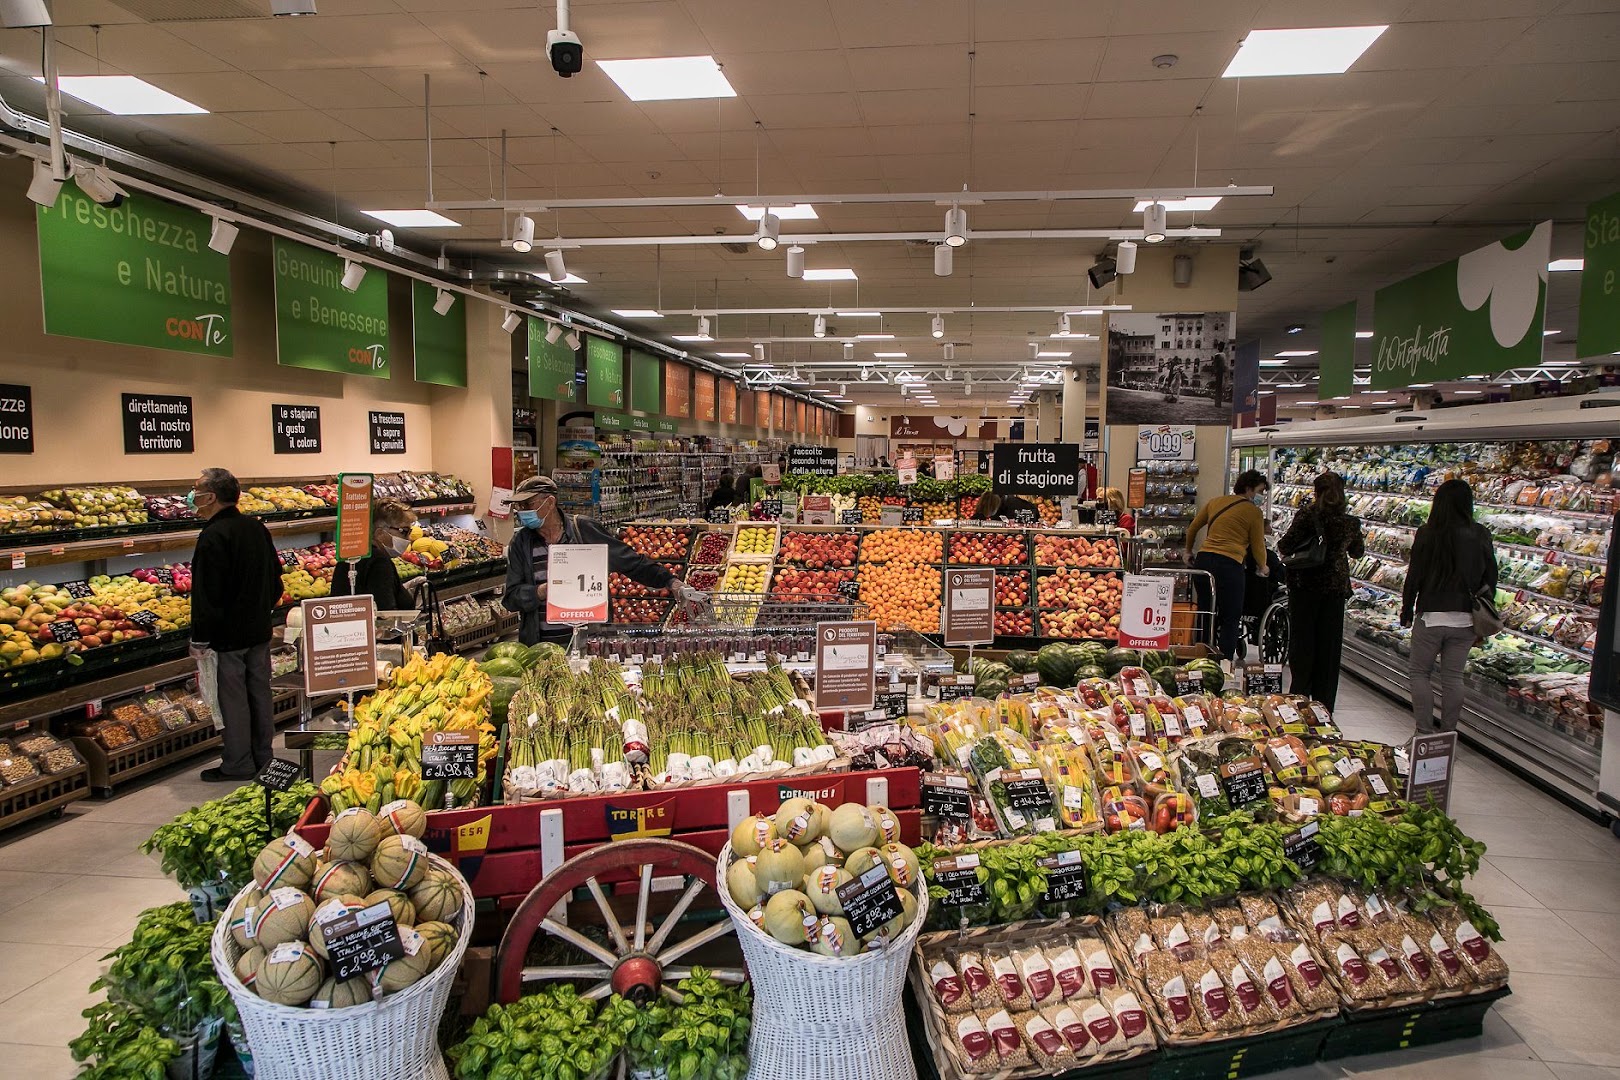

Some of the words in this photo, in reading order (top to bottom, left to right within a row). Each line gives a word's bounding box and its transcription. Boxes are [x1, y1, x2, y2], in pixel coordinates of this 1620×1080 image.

[42, 193, 198, 252] reschezza
[117, 260, 131, 285] e
[146, 257, 226, 304] Natura
[1604, 269, 1614, 295] e
[292, 299, 300, 319] e
[310, 296, 386, 336] Benessere
[128, 398, 188, 414] direttamente
[280, 406, 288, 419] le
[290, 408, 317, 421] stagioni
[372, 414, 378, 424] la
[378, 414, 404, 425] freschezza
[140, 418, 156, 432] dal
[160, 419, 190, 432] nostro
[278, 422, 283, 434] il
[286, 424, 305, 437] gusto
[376, 426, 382, 436] il
[382, 428, 400, 439] sapore
[139, 435, 182, 450] territorio
[289, 436, 295, 448] il
[297, 436, 317, 448] colore
[374, 439, 380, 450] la
[820, 458, 836, 466] tempi
[1018, 448, 1056, 463] frutta
[999, 470, 1011, 484] di
[1016, 470, 1074, 489] stagione
[426, 768, 433, 776] €
[611, 808, 665, 820] TORRE
[857, 924, 863, 933] €
[337, 944, 364, 958] ITALIA
[340, 966, 348, 977] €
